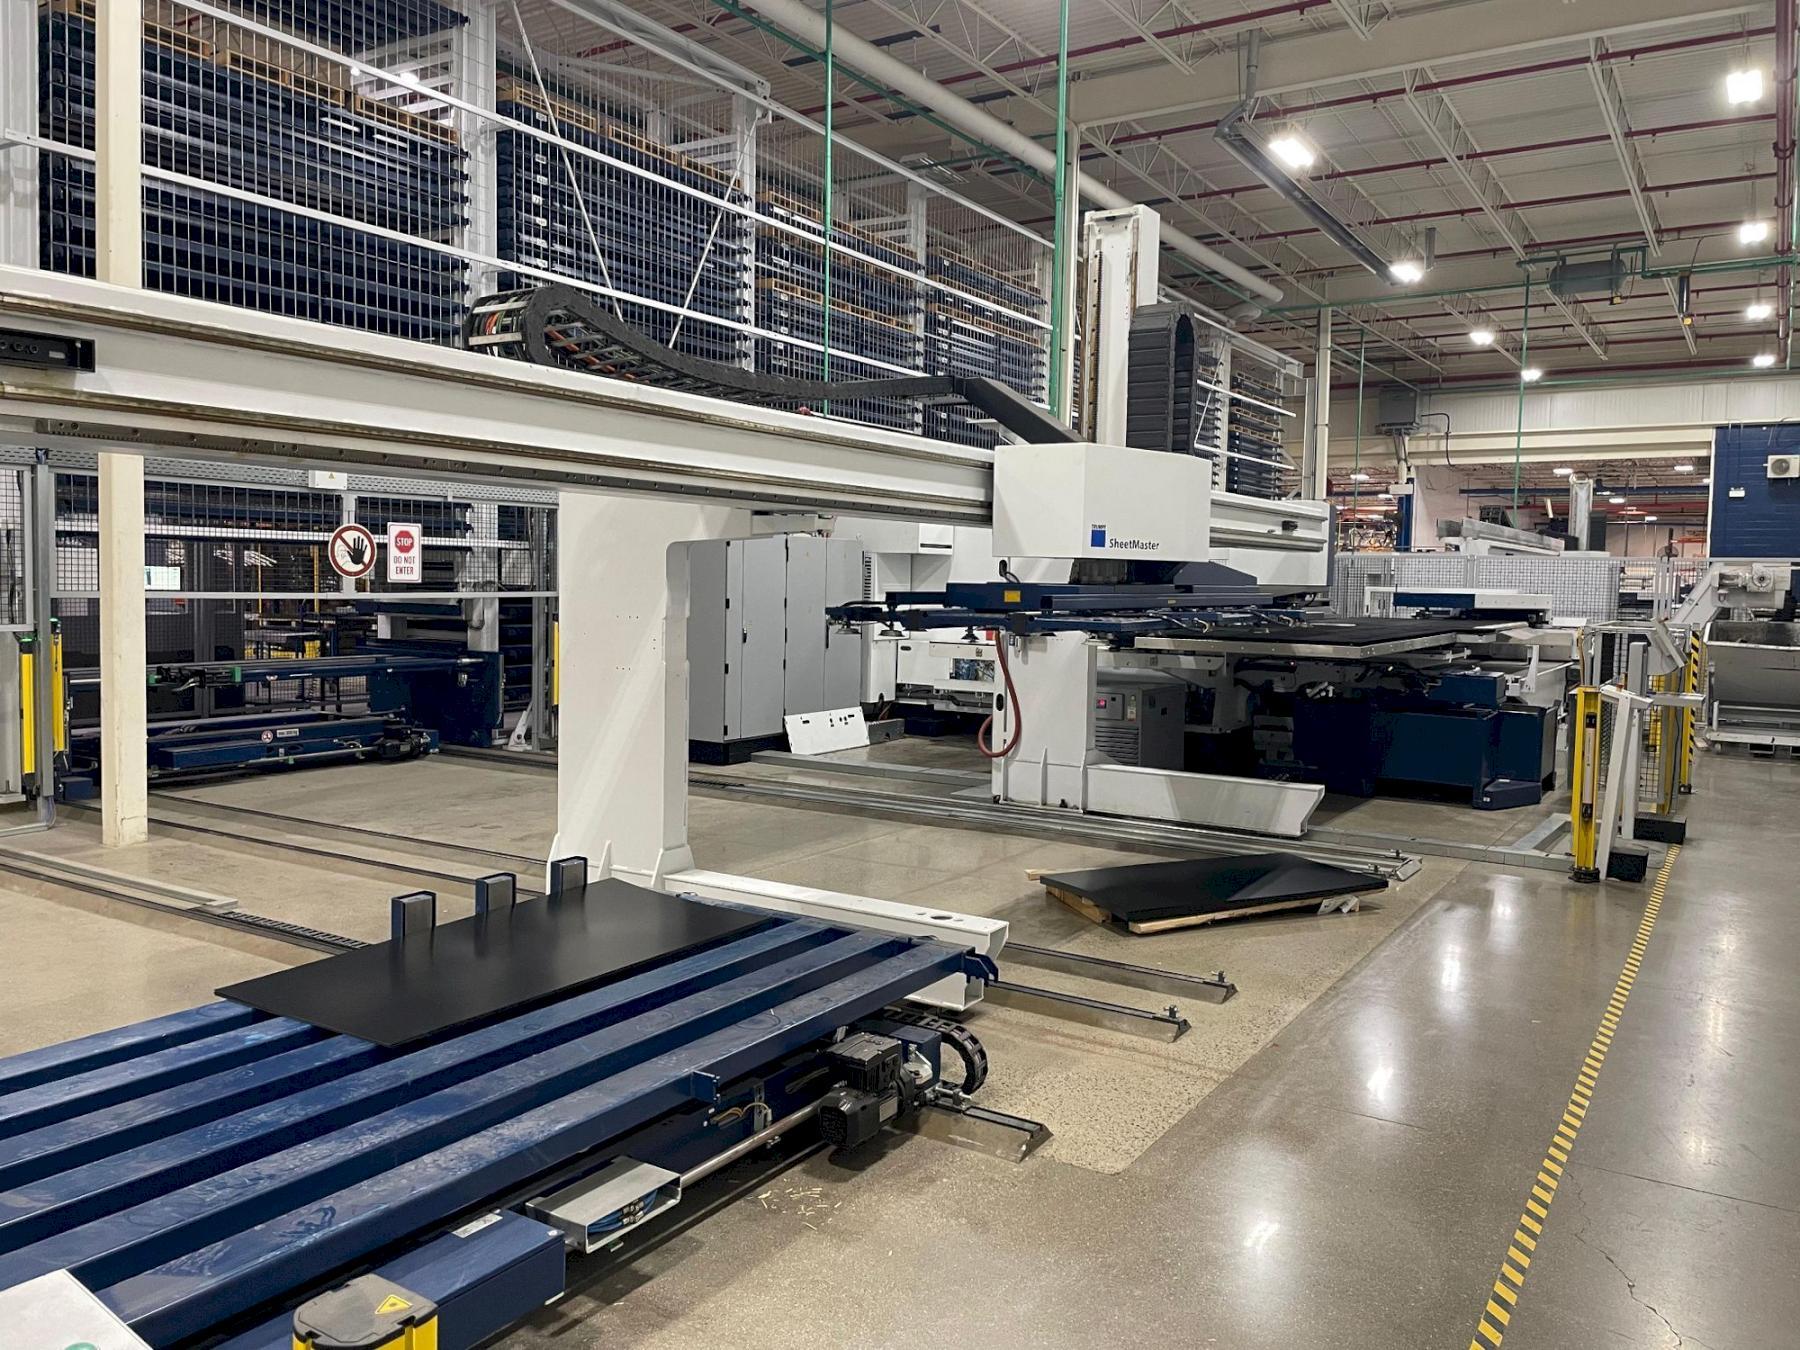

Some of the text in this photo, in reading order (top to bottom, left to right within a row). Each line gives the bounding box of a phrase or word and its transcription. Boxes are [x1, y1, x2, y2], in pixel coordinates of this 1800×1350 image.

[396, 537, 413, 547] STOP
[1109, 538, 1160, 550] SheetMaster
[393, 556, 416, 565] DO NOT
[395, 566, 414, 575] ENTER
